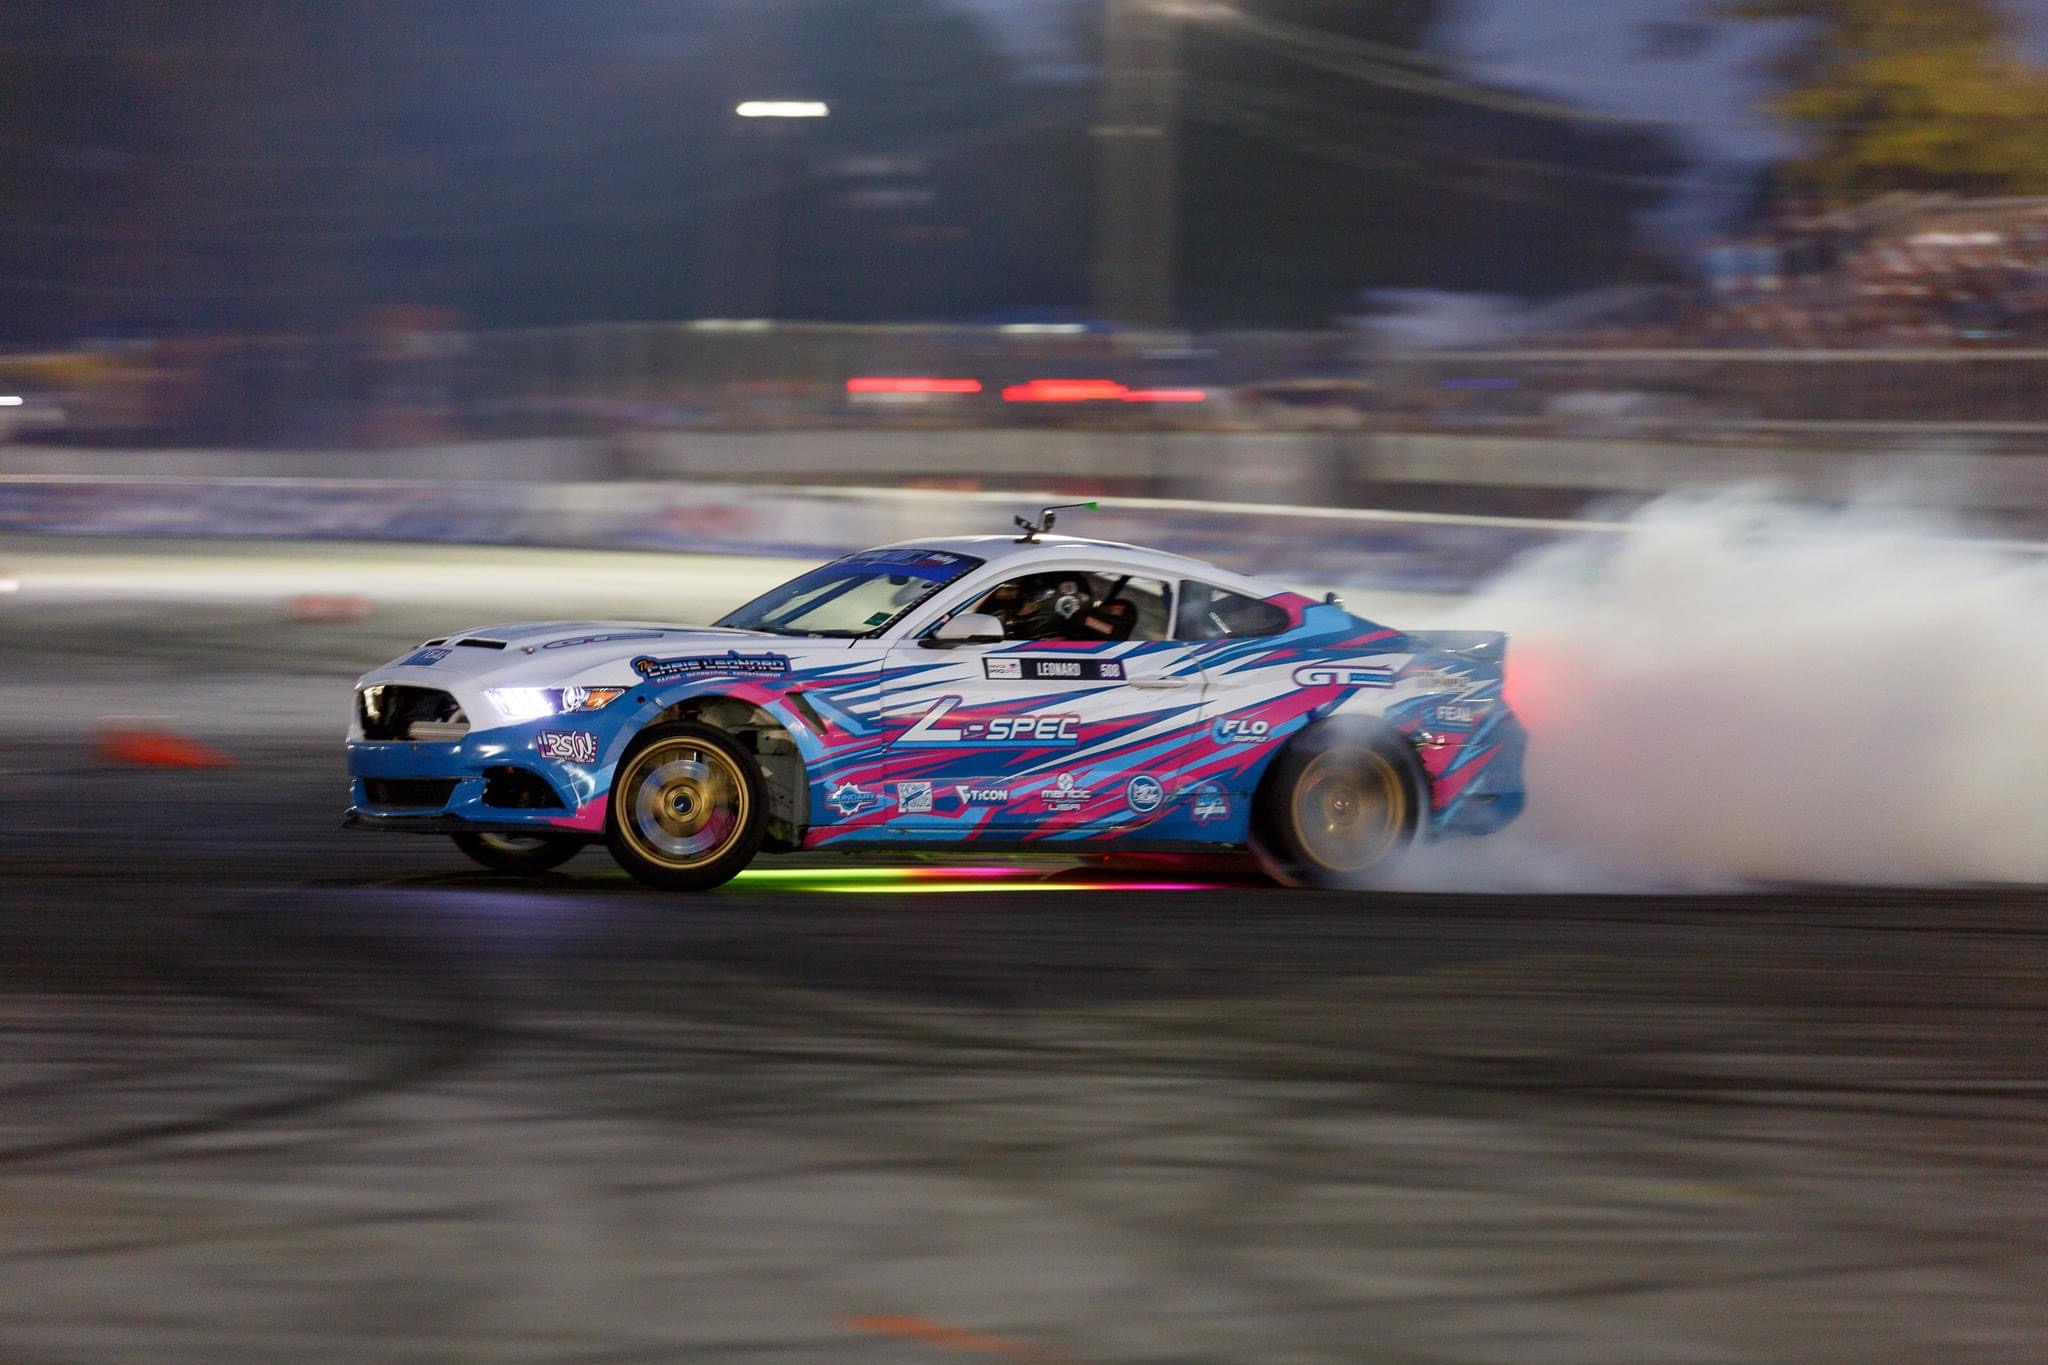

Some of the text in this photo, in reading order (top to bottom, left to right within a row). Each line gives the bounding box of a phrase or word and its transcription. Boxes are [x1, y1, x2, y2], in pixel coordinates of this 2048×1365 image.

[648, 660, 700, 677] CHRIS
[704, 657, 786, 672] LEONARD
[1036, 662, 1081, 677] LEONARD
[1100, 664, 1121, 678] 508
[897, 697, 1079, 741] L-SPEC
[1221, 720, 1269, 735] FLO
